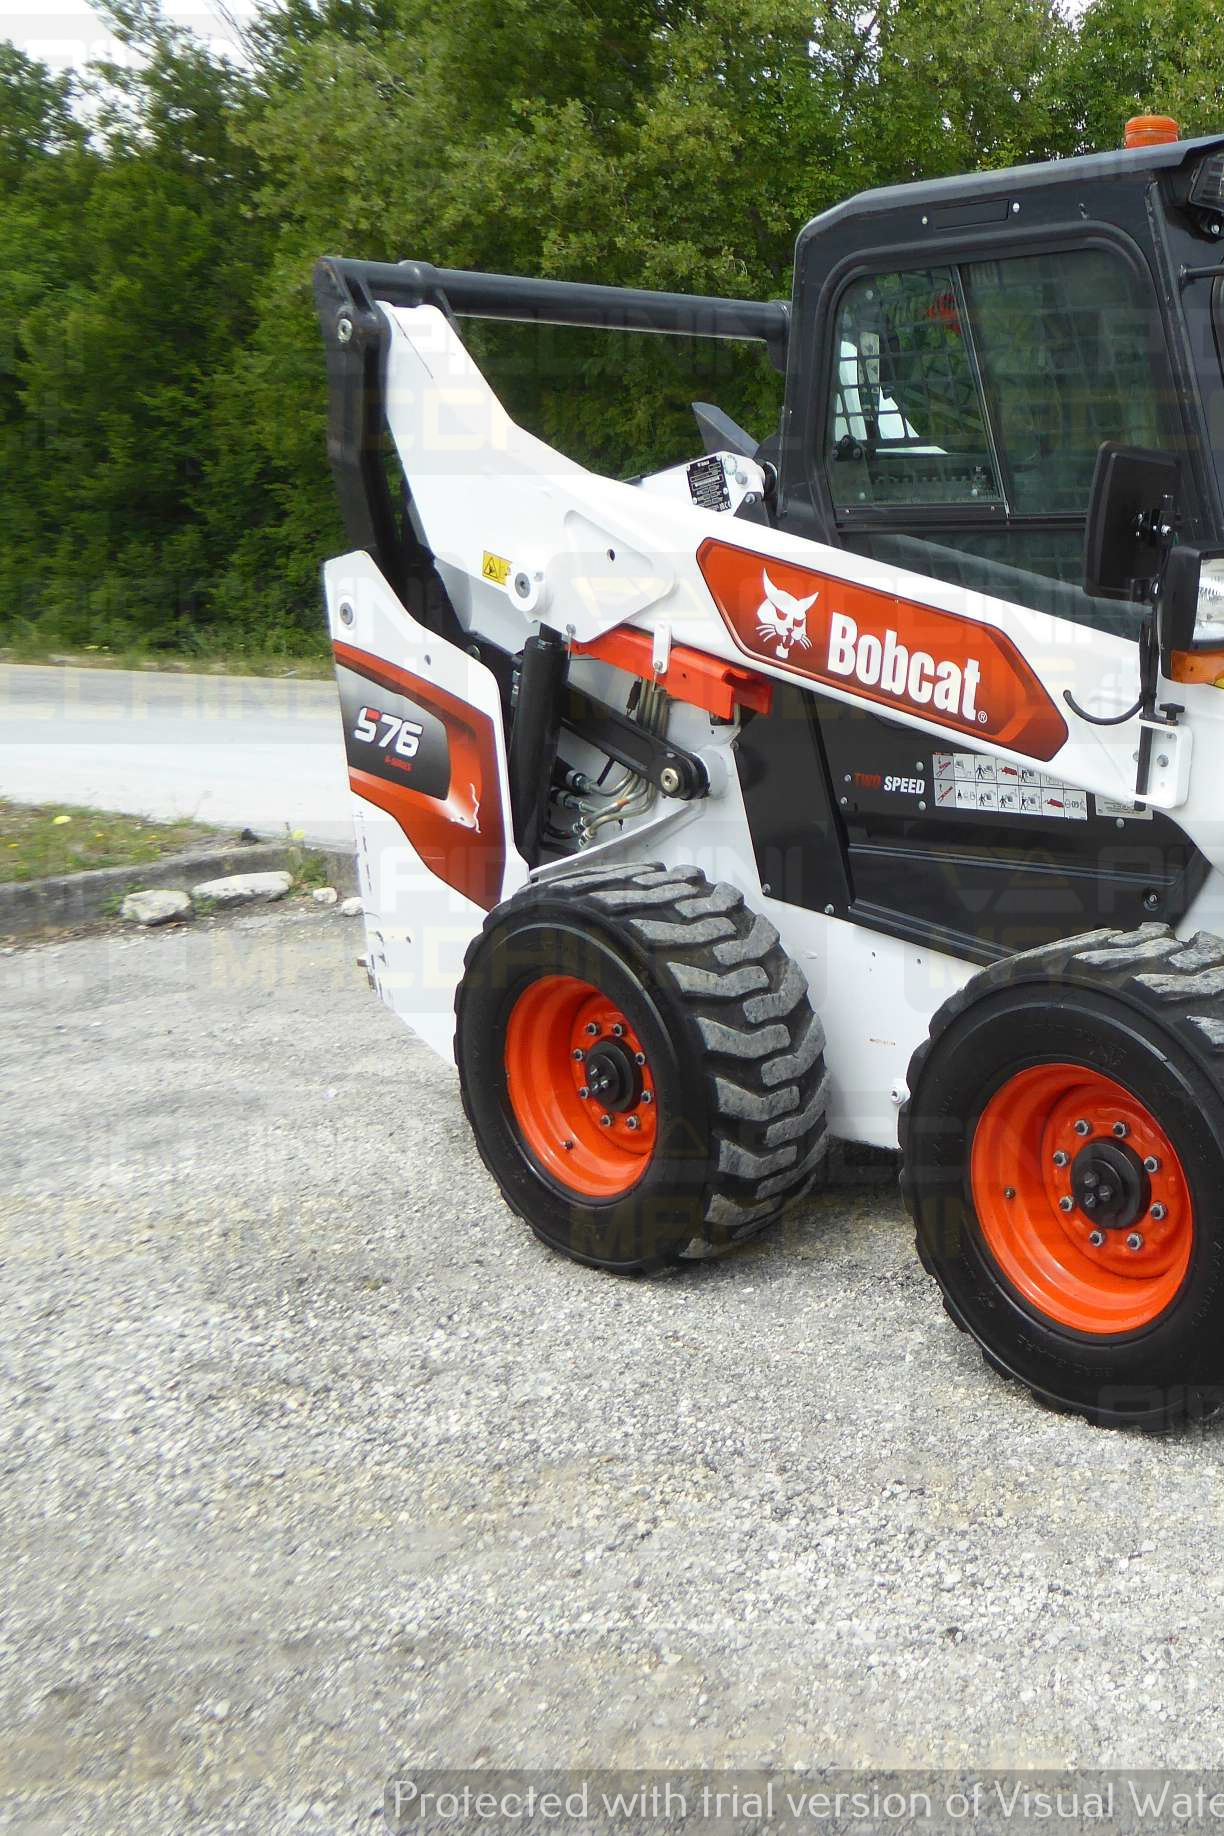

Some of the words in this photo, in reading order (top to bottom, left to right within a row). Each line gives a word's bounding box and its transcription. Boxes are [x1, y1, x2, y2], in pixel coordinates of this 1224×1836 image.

[827, 612, 981, 721] Bobcat
[354, 707, 424, 757] S76
[884, 776, 926, 795] SPEED
